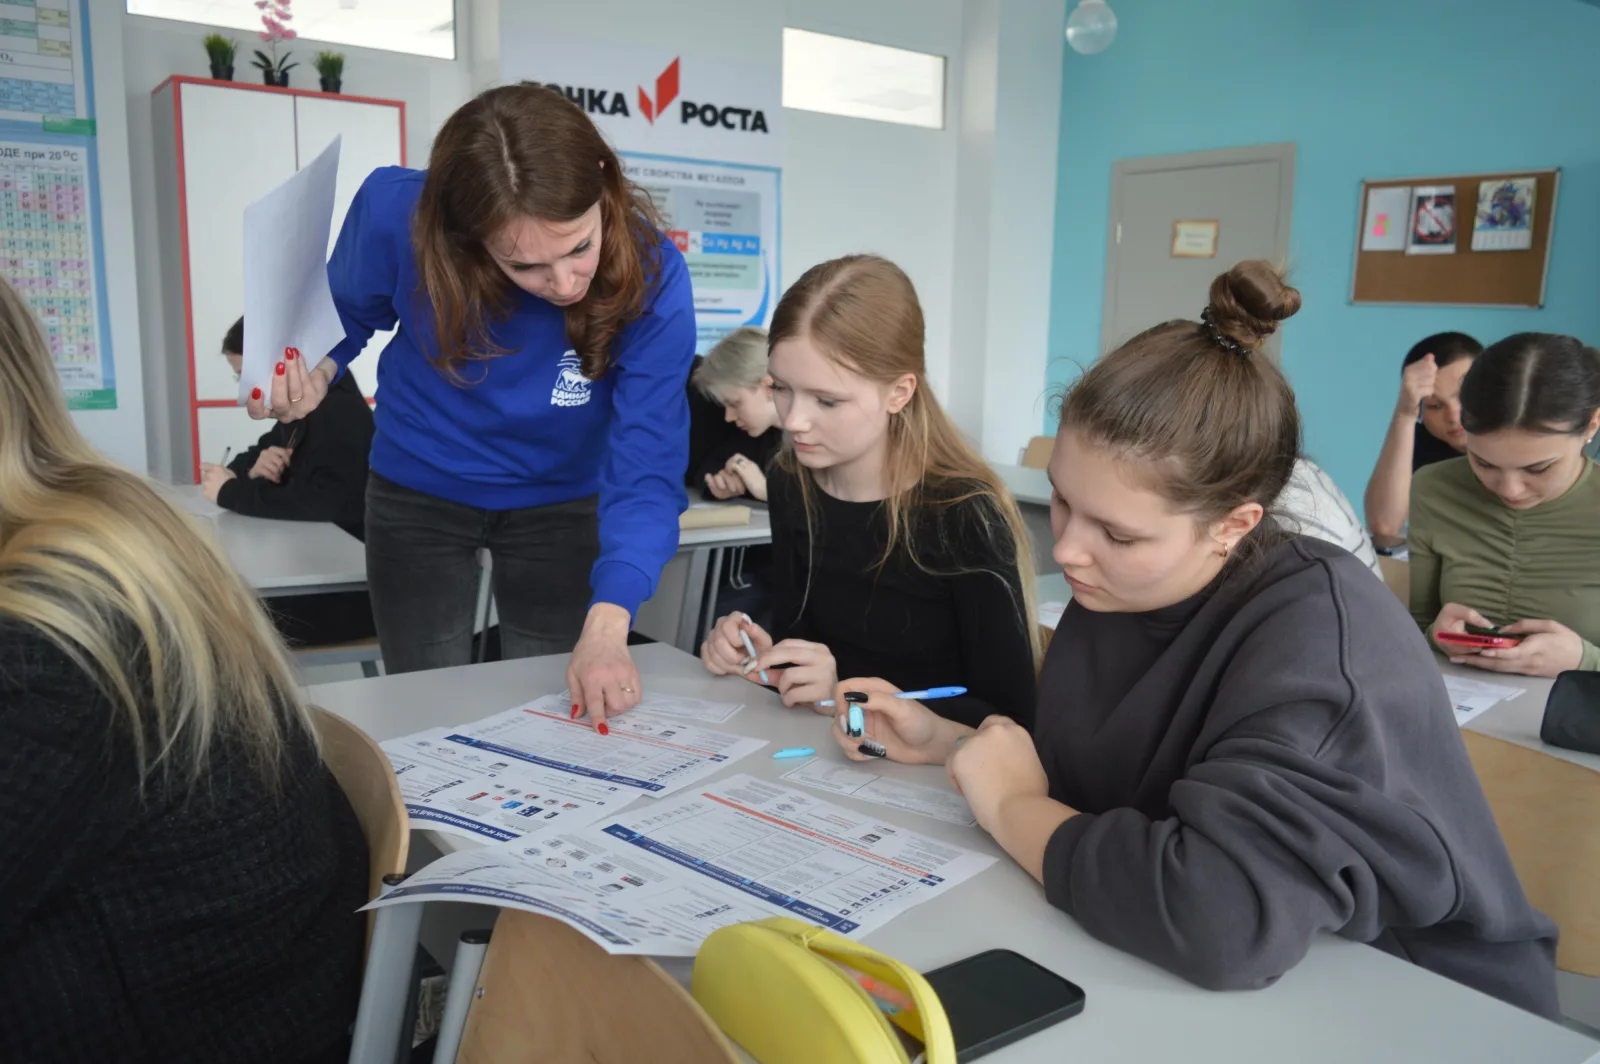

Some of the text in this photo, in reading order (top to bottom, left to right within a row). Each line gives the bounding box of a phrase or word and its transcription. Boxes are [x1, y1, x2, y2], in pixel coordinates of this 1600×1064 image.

[521, 80, 630, 117] ЧКА
[681, 101, 768, 133] РОСТА
[24, 151, 45, 160] при
